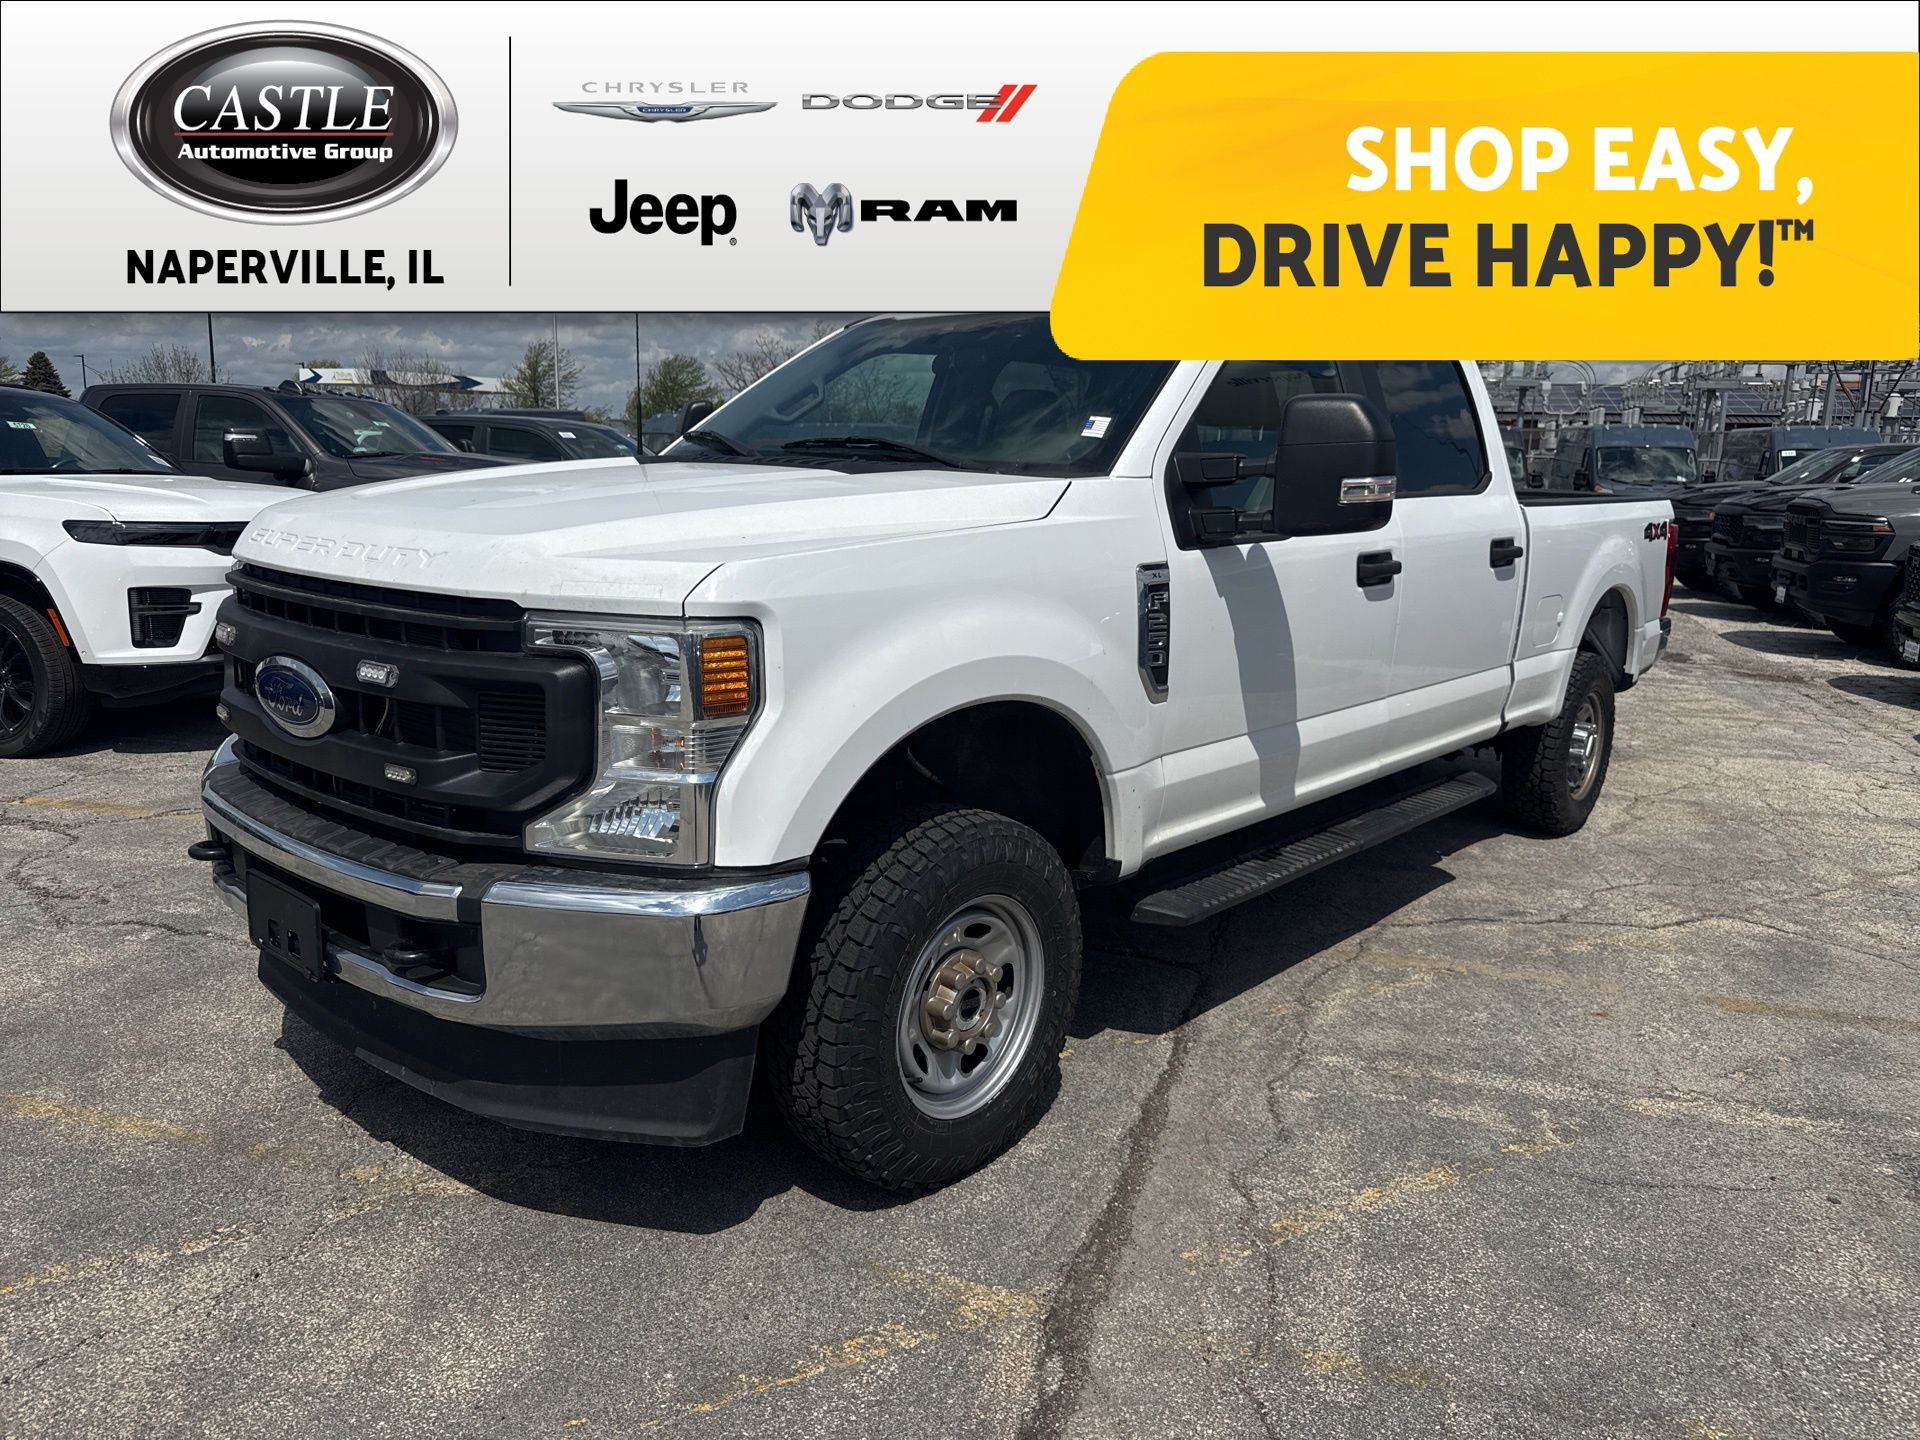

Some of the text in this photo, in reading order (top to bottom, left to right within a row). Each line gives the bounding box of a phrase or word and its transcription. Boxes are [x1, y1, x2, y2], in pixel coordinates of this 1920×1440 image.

[247, 527, 449, 569] SUPER DUTY
[264, 677, 305, 717] Ford
